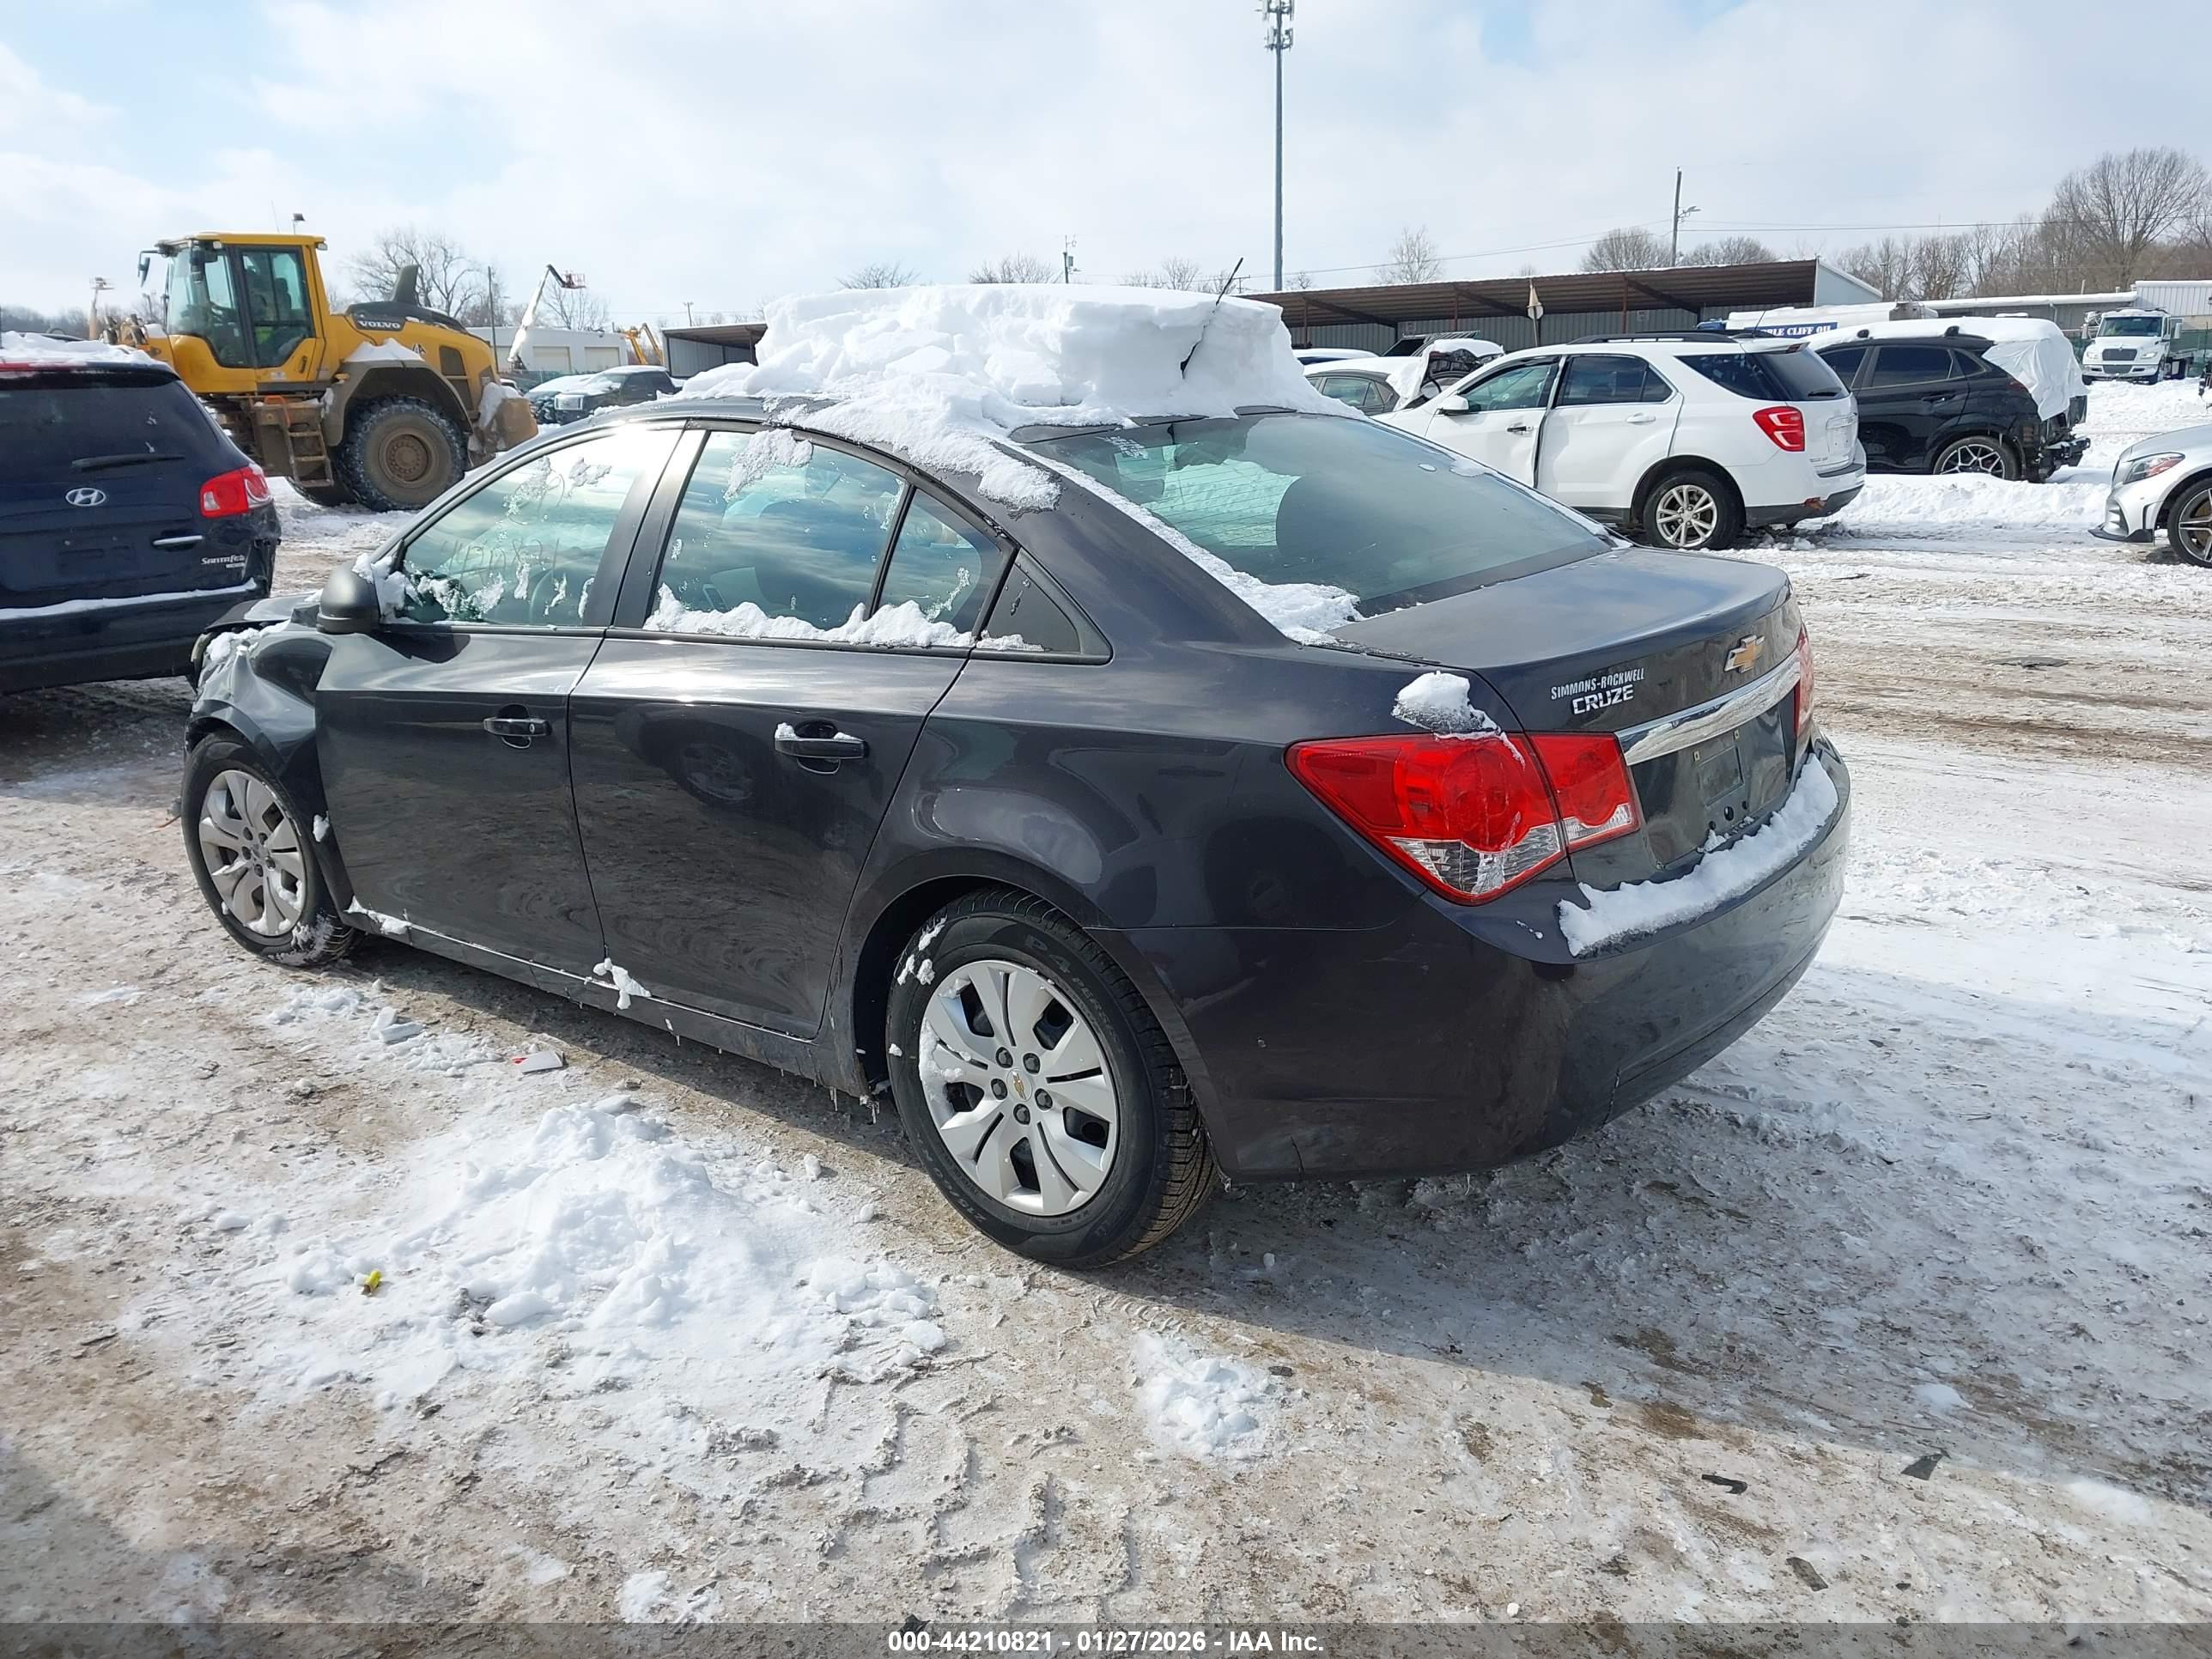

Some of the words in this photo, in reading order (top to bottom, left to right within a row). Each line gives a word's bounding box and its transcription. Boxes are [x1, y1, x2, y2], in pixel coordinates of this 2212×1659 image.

[357, 320, 401, 329] VOLVO
[1786, 326, 1814, 336] CLIFF
[1551, 666, 1645, 701] SIMMONS-ROCKWELL
[1571, 684, 1634, 715] CRUZE
